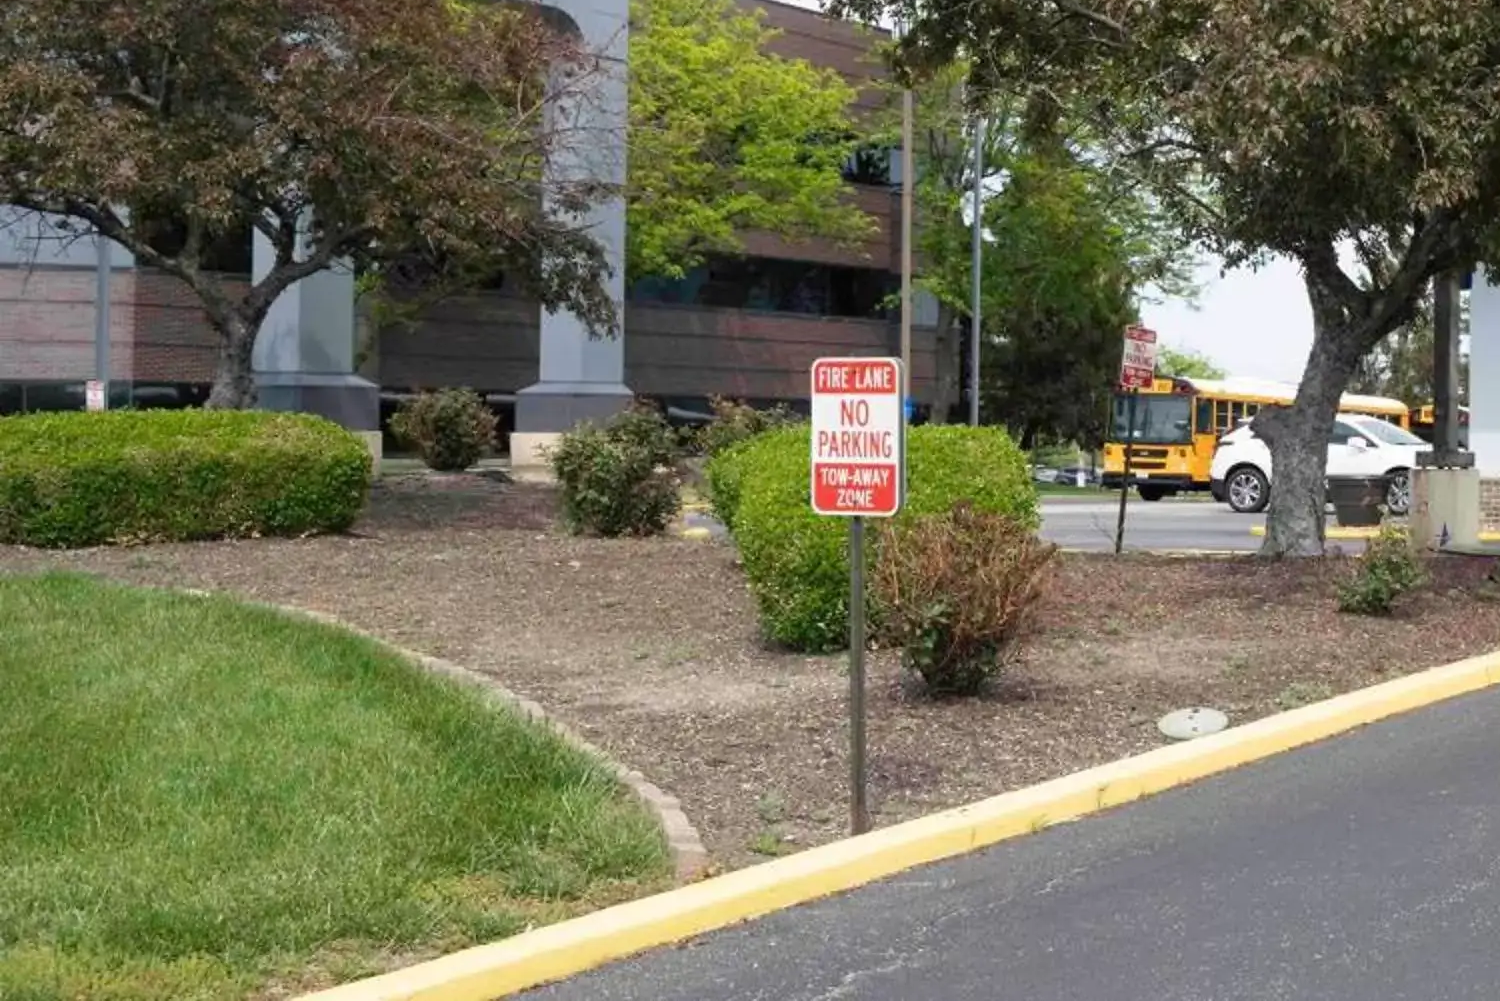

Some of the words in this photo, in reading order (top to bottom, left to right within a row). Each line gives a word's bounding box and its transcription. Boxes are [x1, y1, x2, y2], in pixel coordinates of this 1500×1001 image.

[818, 366, 849, 389] FIRE
[855, 367, 893, 389] LANE
[840, 398, 870, 427] NO
[817, 430, 893, 459] PARKING
[820, 466, 890, 487] TOW-AWAY
[836, 487, 875, 508] ZONE
